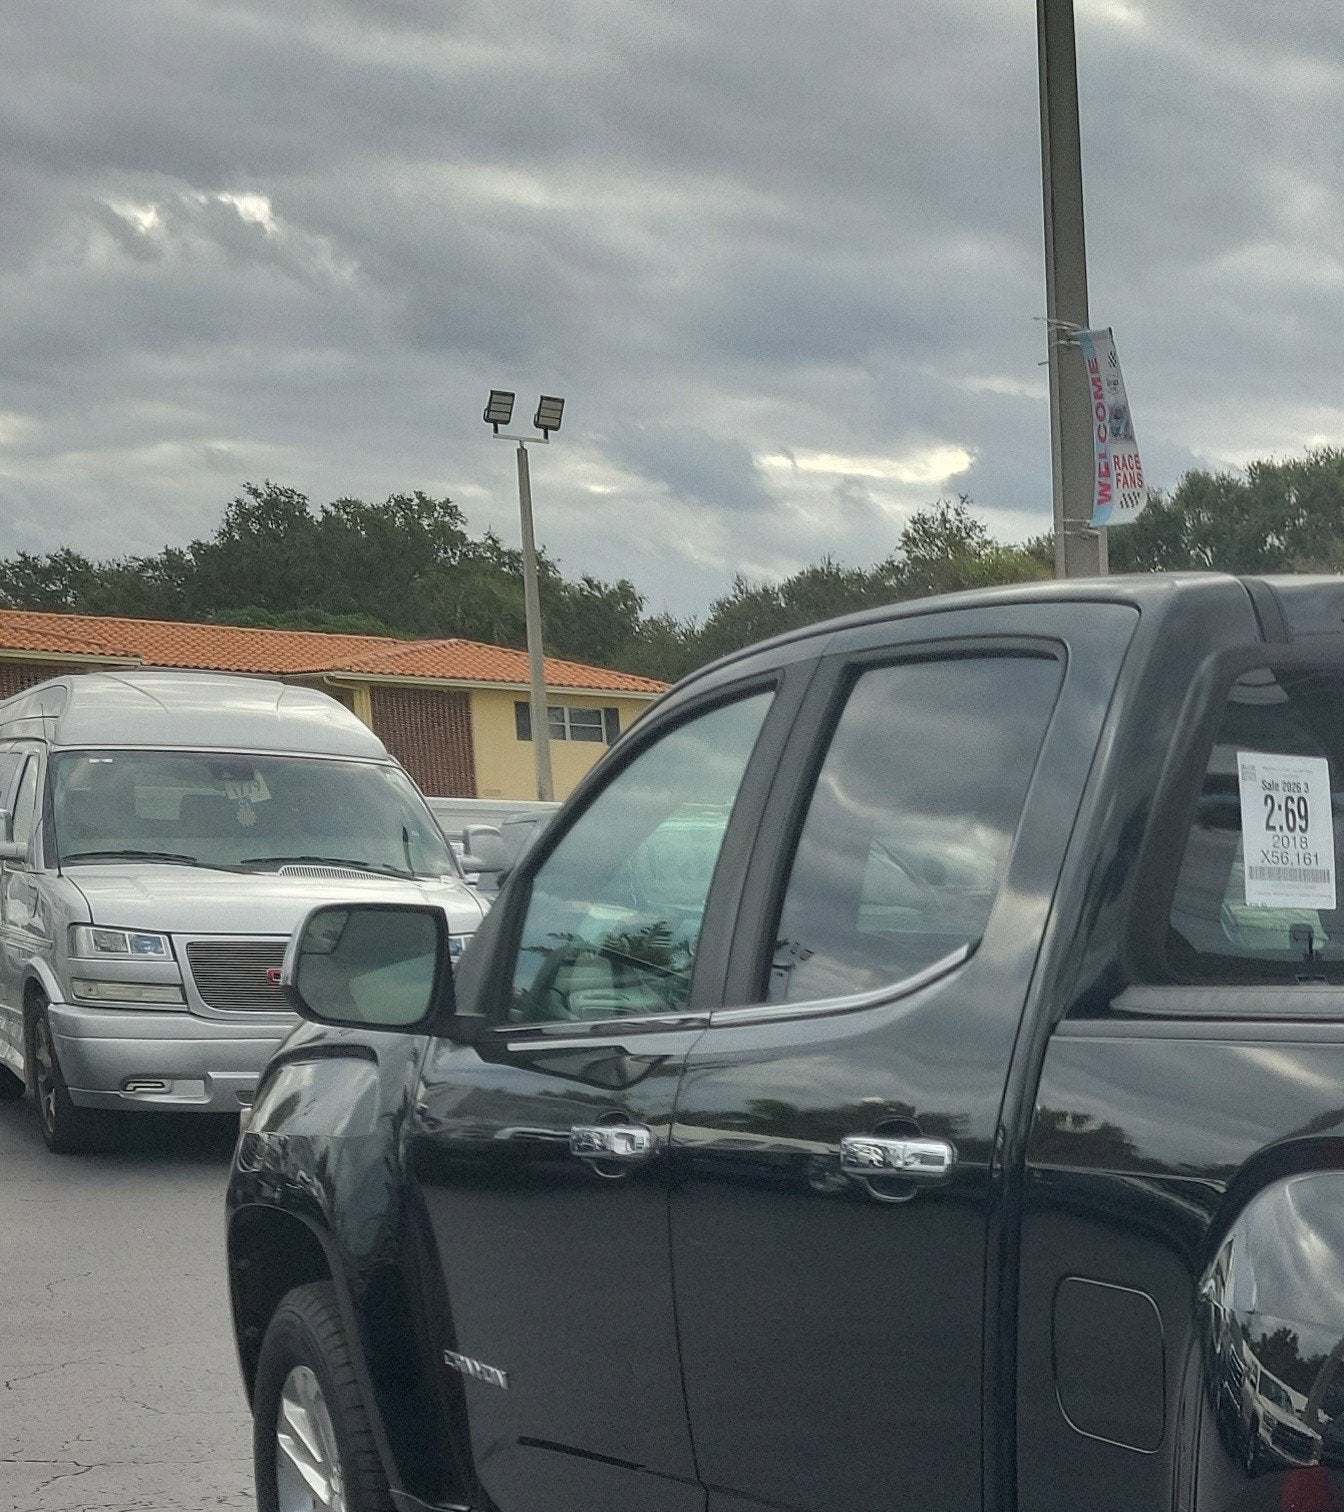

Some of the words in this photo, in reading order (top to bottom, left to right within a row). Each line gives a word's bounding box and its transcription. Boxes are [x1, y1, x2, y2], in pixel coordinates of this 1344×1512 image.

[1087, 357, 1112, 506] WELCOME
[1113, 453, 1141, 470] RACE
[1115, 472, 1144, 489] FANS
[1261, 779, 1279, 791] Sale
[1263, 794, 1309, 833] 2:69
[1272, 835, 1309, 850] 2018
